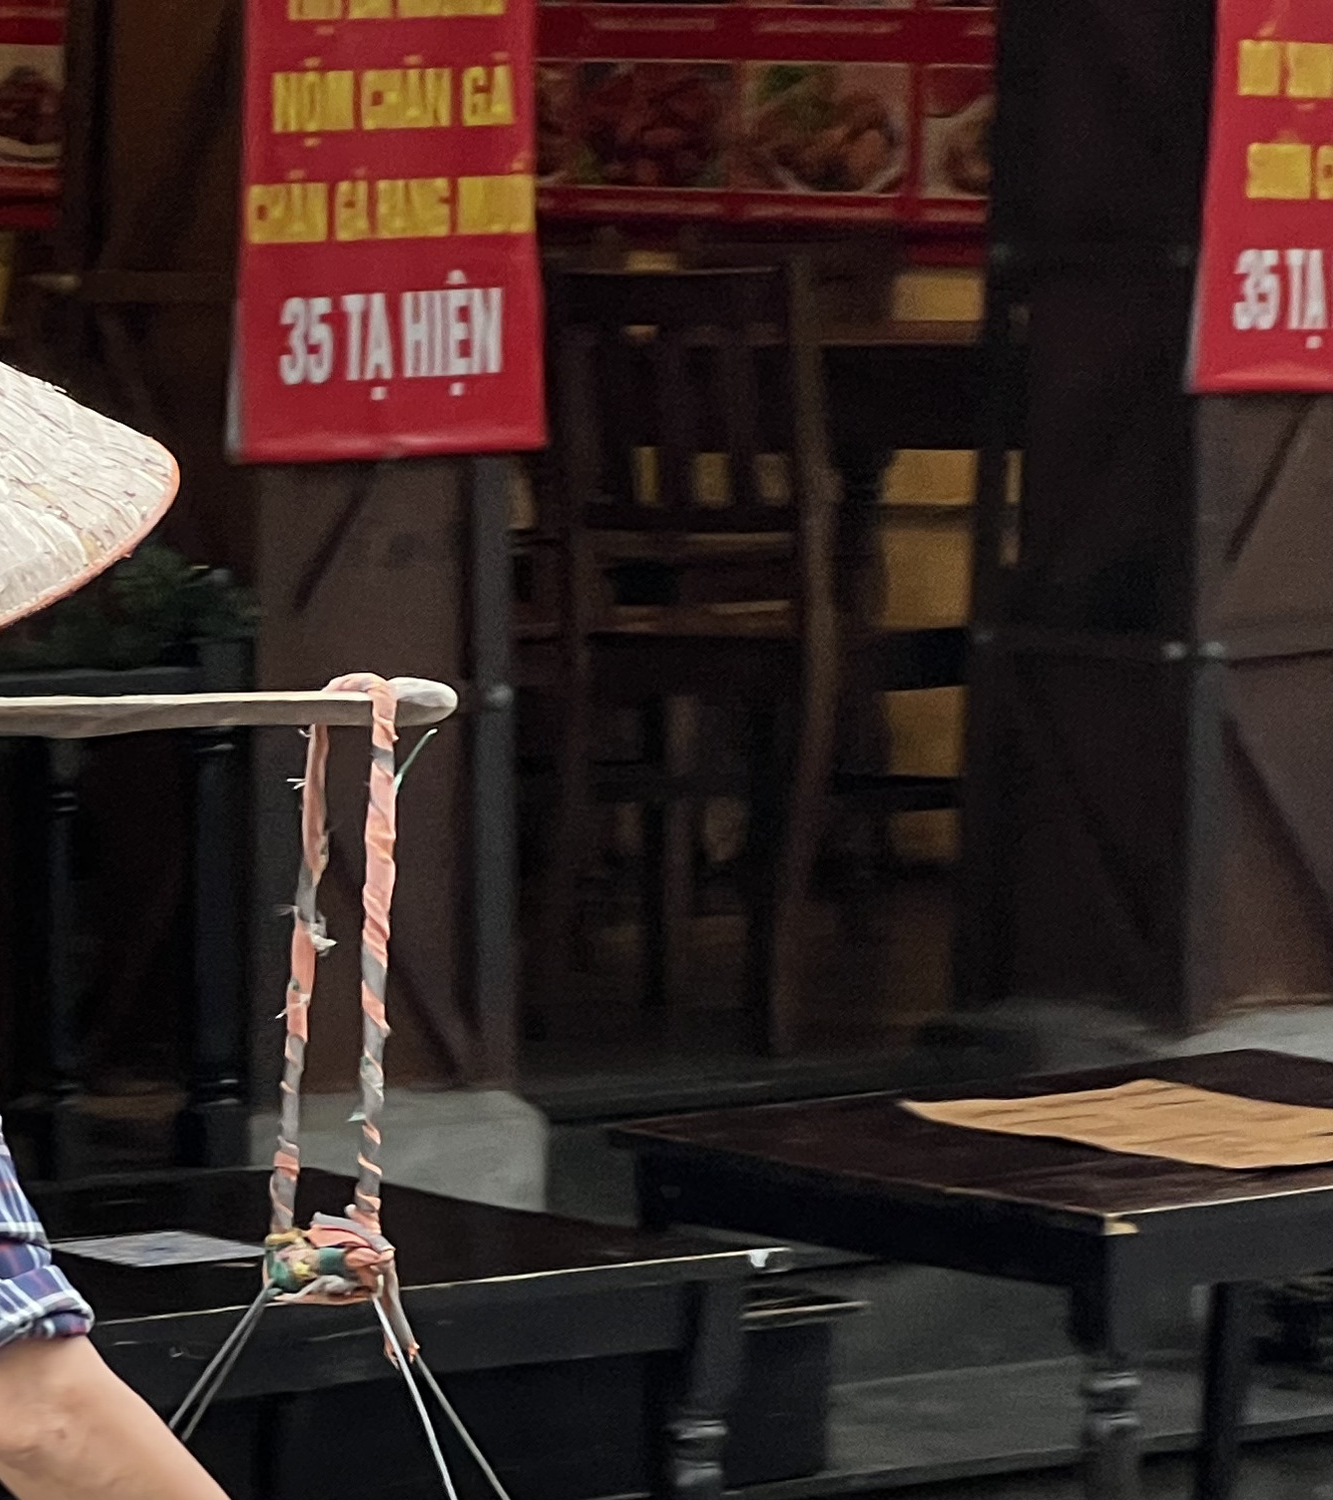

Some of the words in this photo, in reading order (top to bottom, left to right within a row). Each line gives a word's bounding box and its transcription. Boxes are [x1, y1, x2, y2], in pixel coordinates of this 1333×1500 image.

[278, 296, 333, 386] 35
[341, 292, 394, 401] TẠ
[402, 268, 503, 397] HIỆN
[1233, 248, 1280, 331] 35
